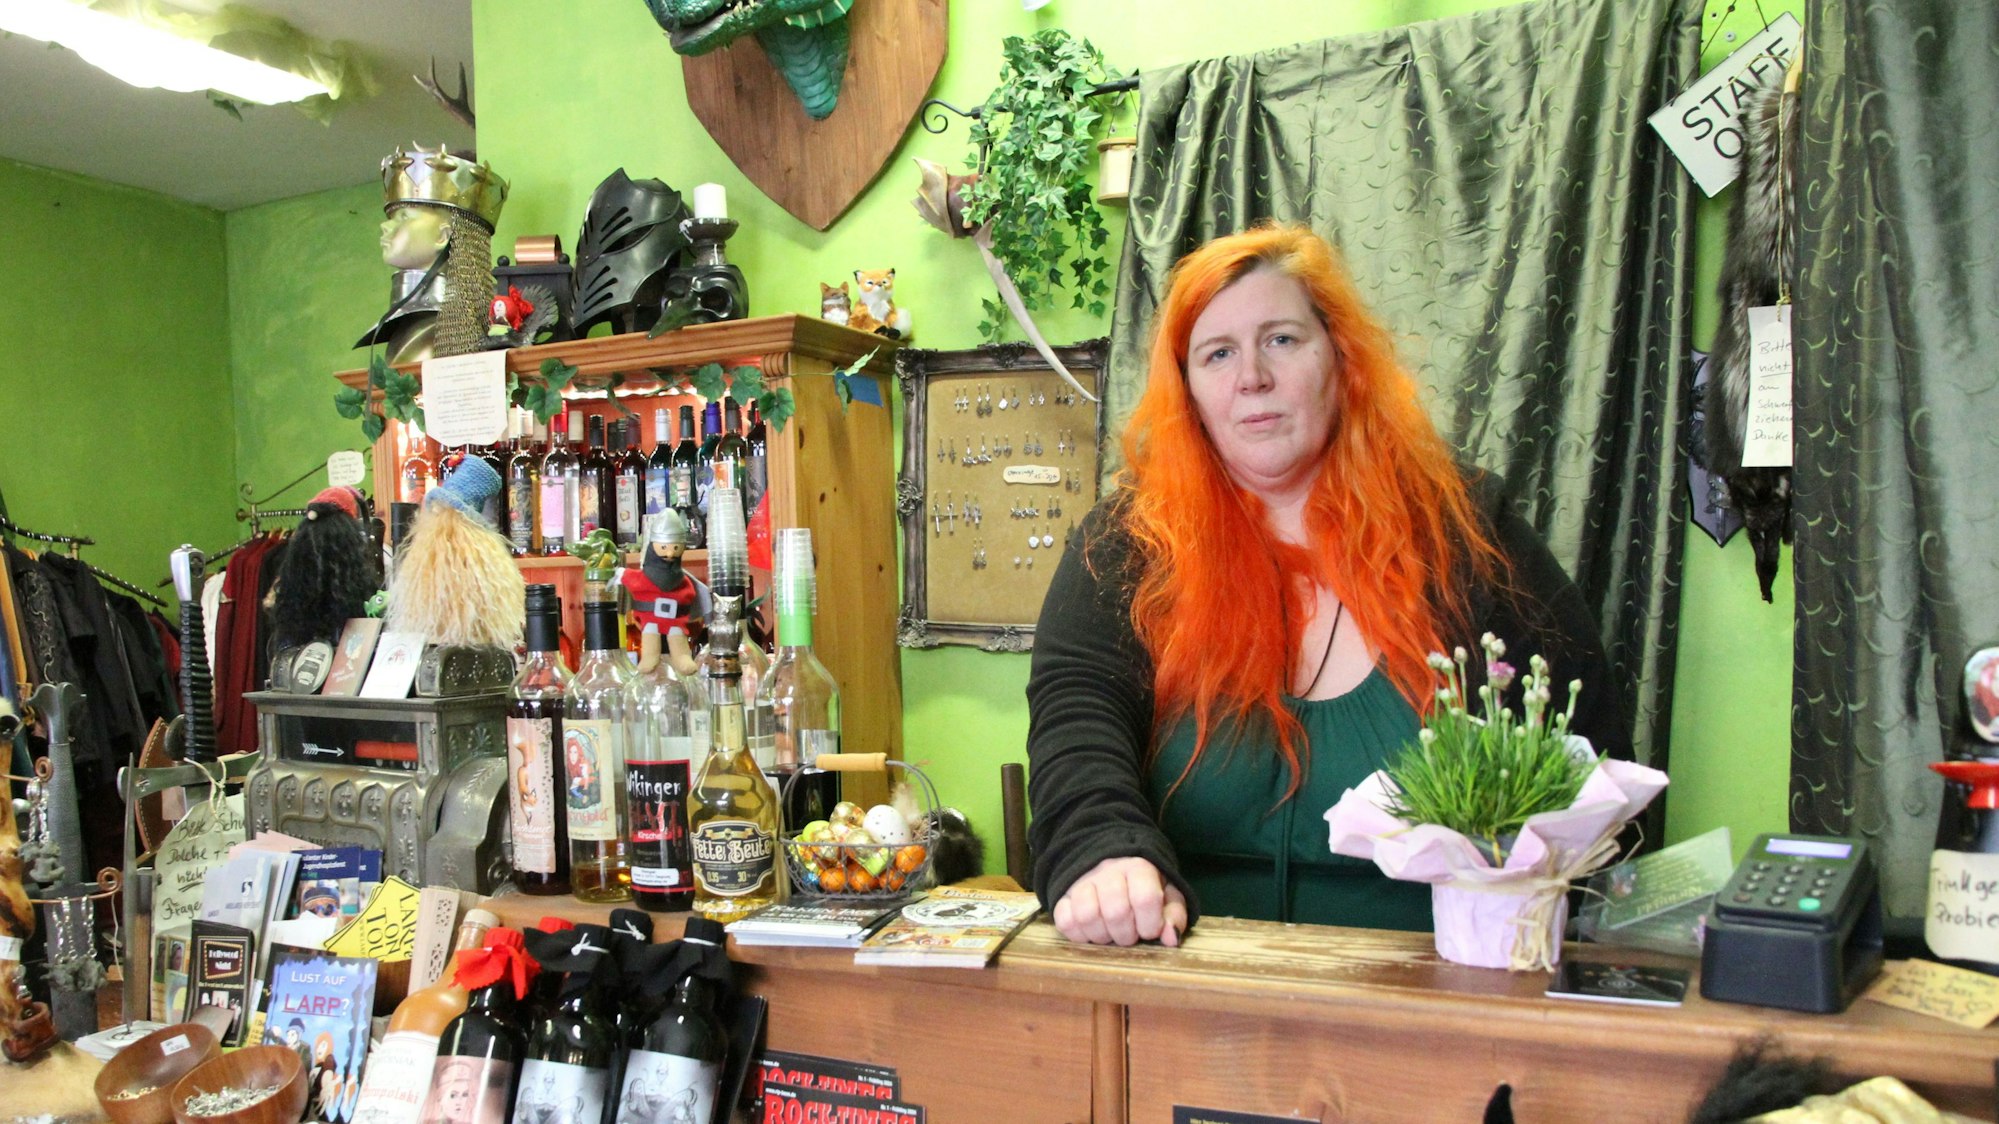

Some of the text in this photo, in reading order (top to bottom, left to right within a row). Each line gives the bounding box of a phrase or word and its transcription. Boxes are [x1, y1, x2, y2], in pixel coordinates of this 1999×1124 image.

[1682, 37, 1789, 141] STAFF
[1713, 126, 1745, 159] O
[1758, 341, 1791, 355] Bitte
[1752, 428, 1789, 442] Danke
[1930, 866, 1999, 901] Trinkge
[1935, 901, 1999, 928] Probie
[291, 970, 347, 986] LUST AUF
[283, 993, 350, 1017] LARP?
